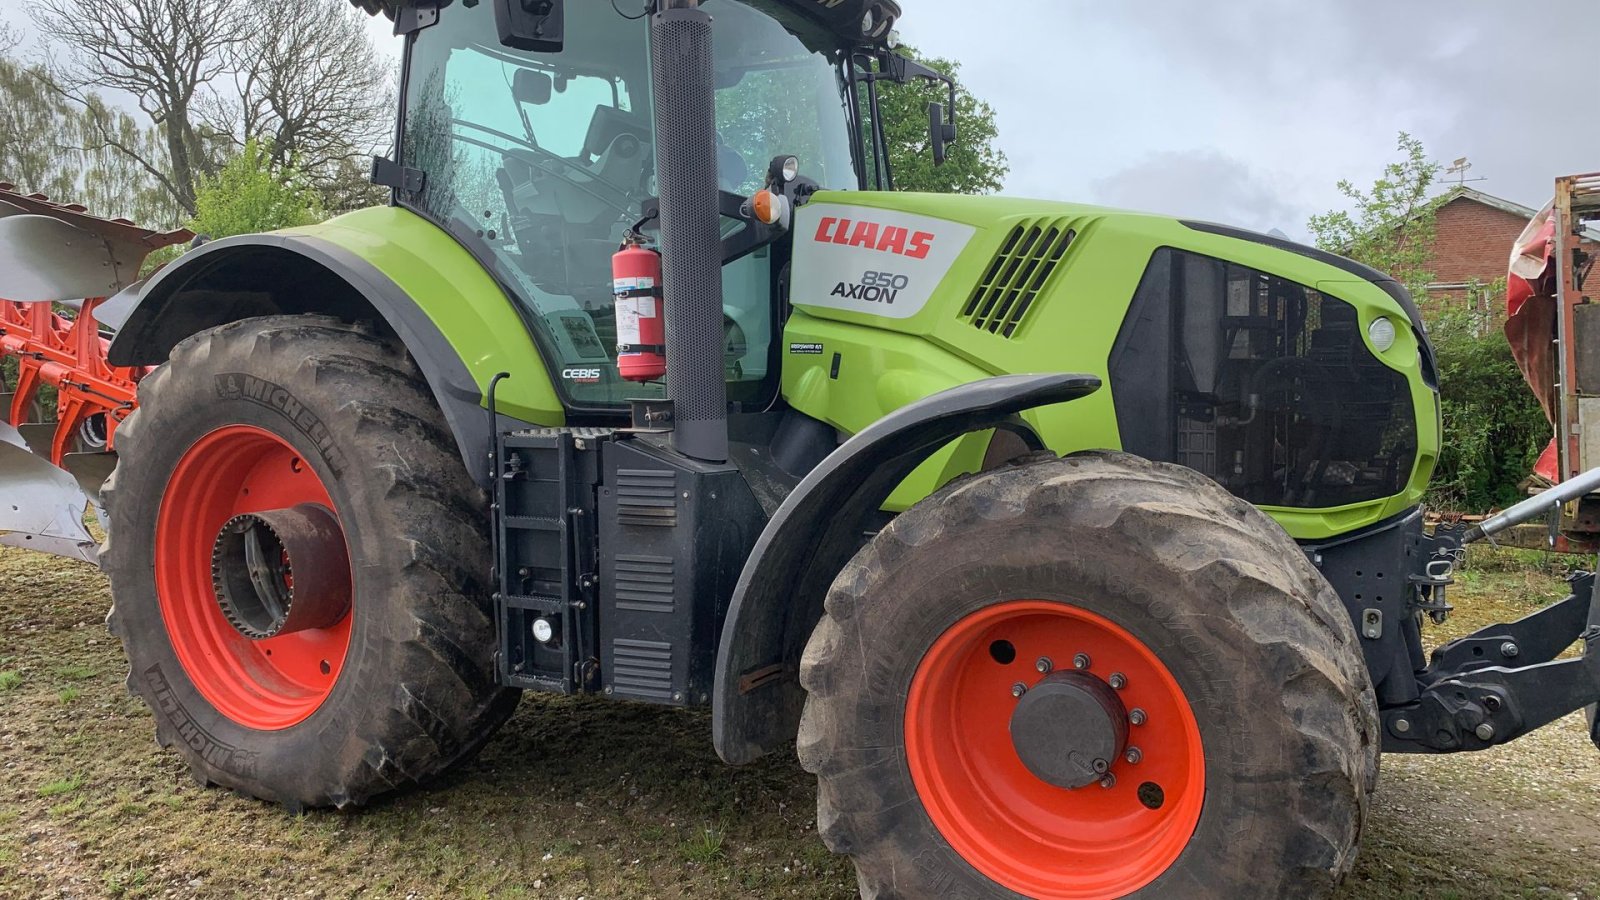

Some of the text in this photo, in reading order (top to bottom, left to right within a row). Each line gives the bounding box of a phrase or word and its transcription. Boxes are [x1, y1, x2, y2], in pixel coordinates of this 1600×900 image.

[814, 217, 935, 260] CLAAS
[830, 281, 898, 304] AXION
[861, 270, 909, 290] 850
[562, 368, 601, 379] CEBIS
[242, 375, 350, 472] MICHELIN
[146, 671, 233, 769] MICHELIN
